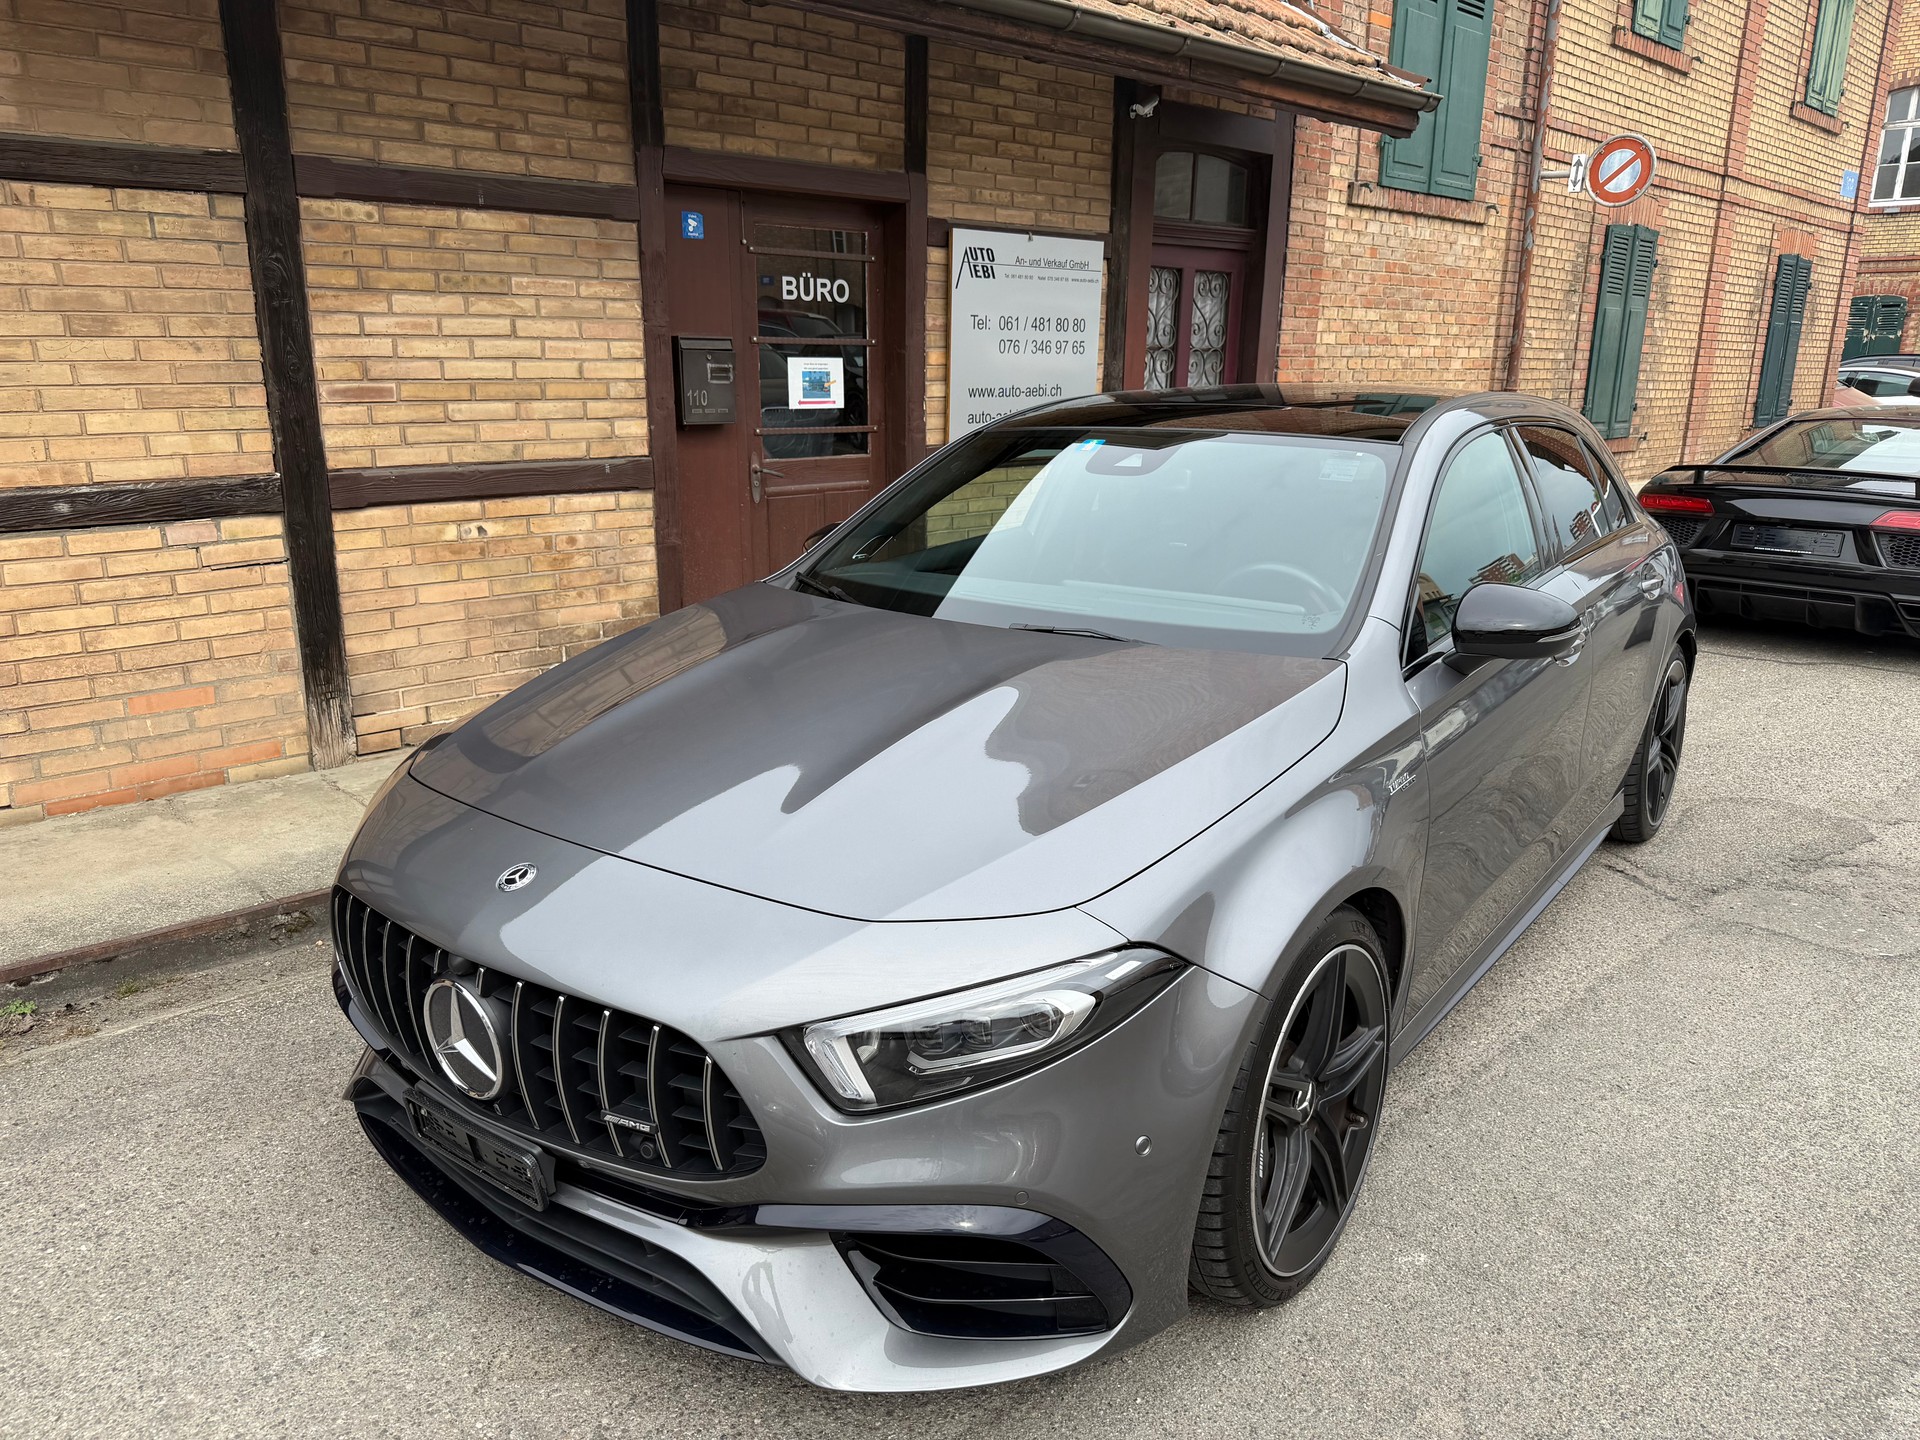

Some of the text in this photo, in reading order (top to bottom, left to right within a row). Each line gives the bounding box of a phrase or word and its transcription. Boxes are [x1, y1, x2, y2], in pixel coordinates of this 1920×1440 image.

[1015, 256, 1089, 269] An- und Verkauf GmbH
[782, 272, 850, 303] BÜRO
[970, 314, 1086, 333] Tel: 061 / 481 80 80
[999, 339, 1085, 355] 076 / 346 97 65
[687, 389, 708, 406] 110
[968, 384, 1062, 398] www.auto-aebi.ch
[618, 1118, 651, 1132] AMG
